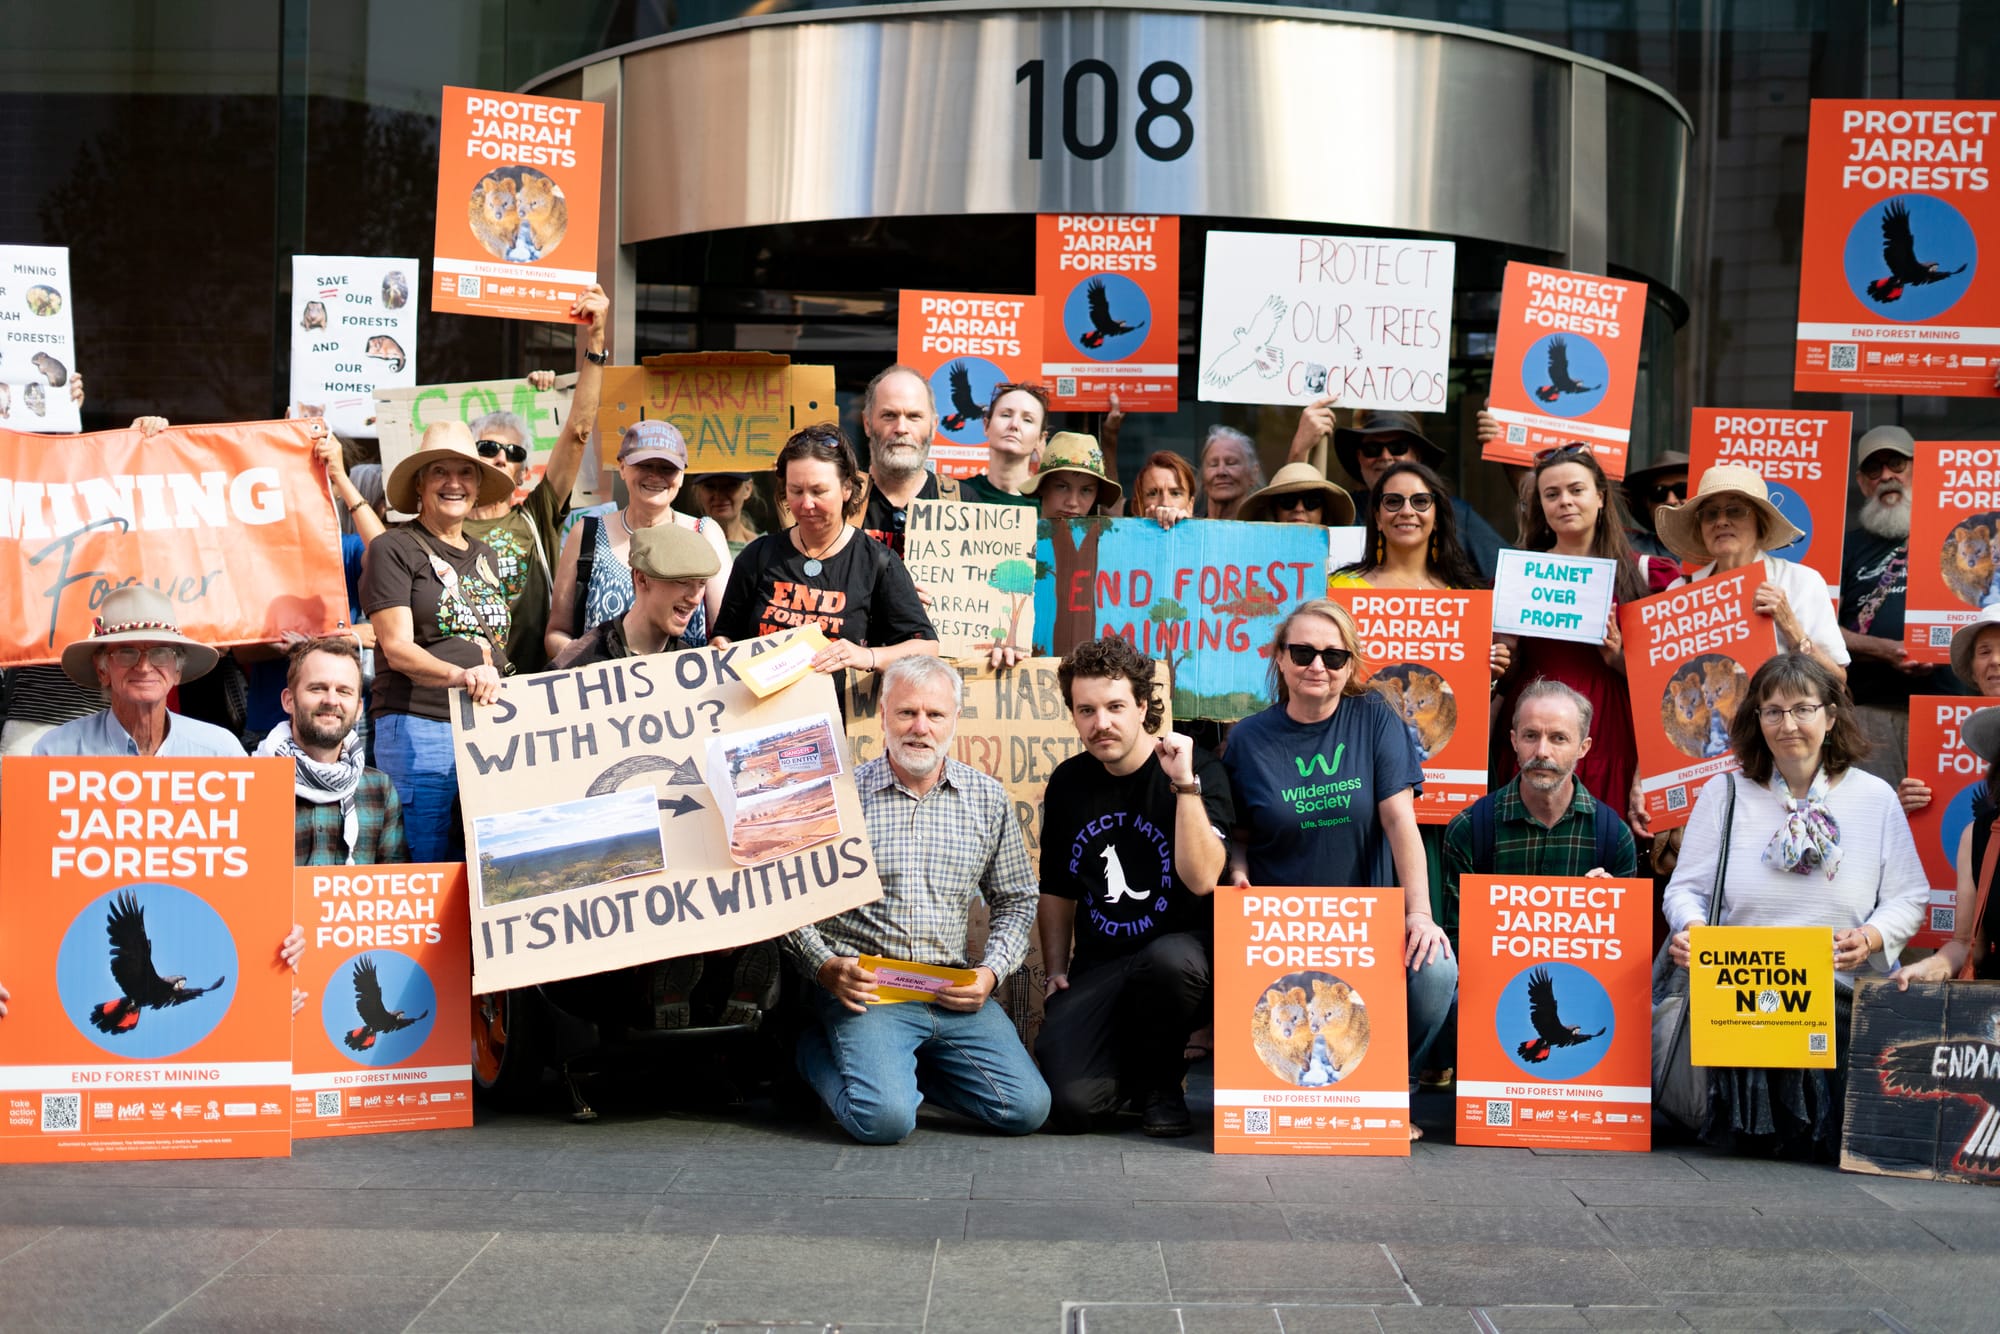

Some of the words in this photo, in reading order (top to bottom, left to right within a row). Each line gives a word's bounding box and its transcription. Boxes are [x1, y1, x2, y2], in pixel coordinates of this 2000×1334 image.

[466, 97, 581, 126] PROTECT
[1016, 59, 1194, 162] 108
[471, 119, 572, 147] JARRAH
[1842, 110, 1997, 135] PROTECT
[466, 139, 576, 168] FORESTS
[1848, 138, 1983, 162] JARRAH
[1842, 166, 1989, 190] FORESTS
[1058, 215, 1159, 233] PROTECT
[1063, 235, 1152, 252] JARRAH
[14, 264, 57, 277] MINING
[1059, 254, 1157, 271] FORESTS
[1298, 238, 1438, 288] PROTECT
[316, 275, 349, 287] SAVE
[1526, 272, 1626, 303] PROTECT
[345, 293, 373, 306] OUR
[921, 297, 1024, 319] PROTECT
[1528, 290, 1618, 320] JARRAH
[341, 315, 399, 328] FORESTS
[926, 316, 1016, 337] JARRAH
[1292, 301, 1355, 345] OUR
[1366, 305, 1441, 349] TREES
[1524, 308, 1620, 340] FORESTS
[7, 332, 65, 344] FORESTS!!
[1851, 329, 1873, 337] END
[1876, 329, 1916, 338] FOREST
[1919, 331, 1960, 340] MINING
[312, 341, 339, 353] AND
[921, 337, 1021, 357] FORESTS
[334, 362, 363, 374] OUR
[650, 370, 785, 413] JARRAH
[1287, 361, 1445, 405] CCKATOOS
[664, 413, 779, 458] SAVE
[1714, 416, 1829, 437] PROTECT
[1719, 437, 1818, 458] JARRAH
[1714, 458, 1822, 480] RESTS
[0, 467, 286, 540] MINING
[910, 504, 1021, 532] MISSING!
[908, 539, 950, 560] HAS
[960, 538, 1022, 556] ANYONE
[29, 516, 222, 648] Forver
[910, 565, 953, 583] SEEN
[962, 565, 998, 581] THE
[1525, 561, 1593, 584] PLANET
[769, 581, 847, 614] END
[1068, 569, 1153, 612] END
[1174, 561, 1314, 605] FOREST
[1532, 586, 1576, 605] OVER
[927, 596, 989, 614] ARRAH
[1351, 597, 1470, 617] PROTECT
[1641, 575, 1746, 625] PROTECT
[761, 606, 844, 634] FOREST
[932, 619, 990, 640] RESTS?
[1357, 618, 1460, 639] JARRAH
[1520, 608, 1583, 630] PROFIT
[1650, 600, 1742, 645] JARRAH
[1102, 618, 1250, 656] MINING
[1649, 620, 1750, 667] FORESTS
[459, 681, 518, 731] IS
[528, 661, 655, 716] THIS
[465, 722, 598, 776] WITH
[607, 700, 726, 748] YOU?
[792, 755, 818, 764] ENTRY
[1678, 770, 1694, 780] END
[1695, 762, 1723, 775] FOREST
[48, 770, 254, 802] PROTECT
[1281, 778, 1362, 802] Wilderness
[1295, 794, 1351, 814] Society
[57, 808, 238, 841] JARRAH
[1318, 815, 1352, 827] Support.
[1069, 812, 1127, 874] ROTECT
[1133, 814, 1171, 888] NATURE
[51, 846, 248, 878] FORESTS
[313, 872, 444, 898] PROTECT
[482, 905, 559, 960] IT'S
[562, 889, 639, 945] NOT
[646, 878, 706, 927] OK
[706, 860, 808, 917] WITH
[811, 836, 868, 889] US
[1243, 896, 1377, 918] PROTECT
[1489, 884, 1626, 910] PROTECT
[320, 898, 435, 923] JARRAH
[1495, 909, 1616, 934] JARRAH
[316, 924, 442, 949] FORESTS
[1250, 921, 1368, 943] JARRAH
[1246, 946, 1376, 968] FORESTS
[1491, 935, 1623, 961] FORESTS
[1699, 951, 1786, 966] CLIMATE
[894, 976, 927, 986] ARSENIC
[1716, 968, 1807, 986] ACTION
[1710, 1019, 1827, 1028] togetherwecanmovement.org.au
[71, 1071, 102, 1083] END
[105, 1070, 161, 1083] FOREST
[164, 1069, 220, 1081] MINING
[334, 1076, 353, 1085] END
[355, 1074, 390, 1084] FOREST
[392, 1071, 428, 1081] MINING
[1263, 1094, 1283, 1103] END
[1285, 1095, 1322, 1103] FOREST
[1324, 1096, 1361, 1104] MINING
[1505, 1086, 1526, 1095] END
[1528, 1087, 1564, 1097] FOREST
[1566, 1089, 1604, 1098] MINING
[10, 1108, 36, 1116] action
[10, 1117, 34, 1126] today
